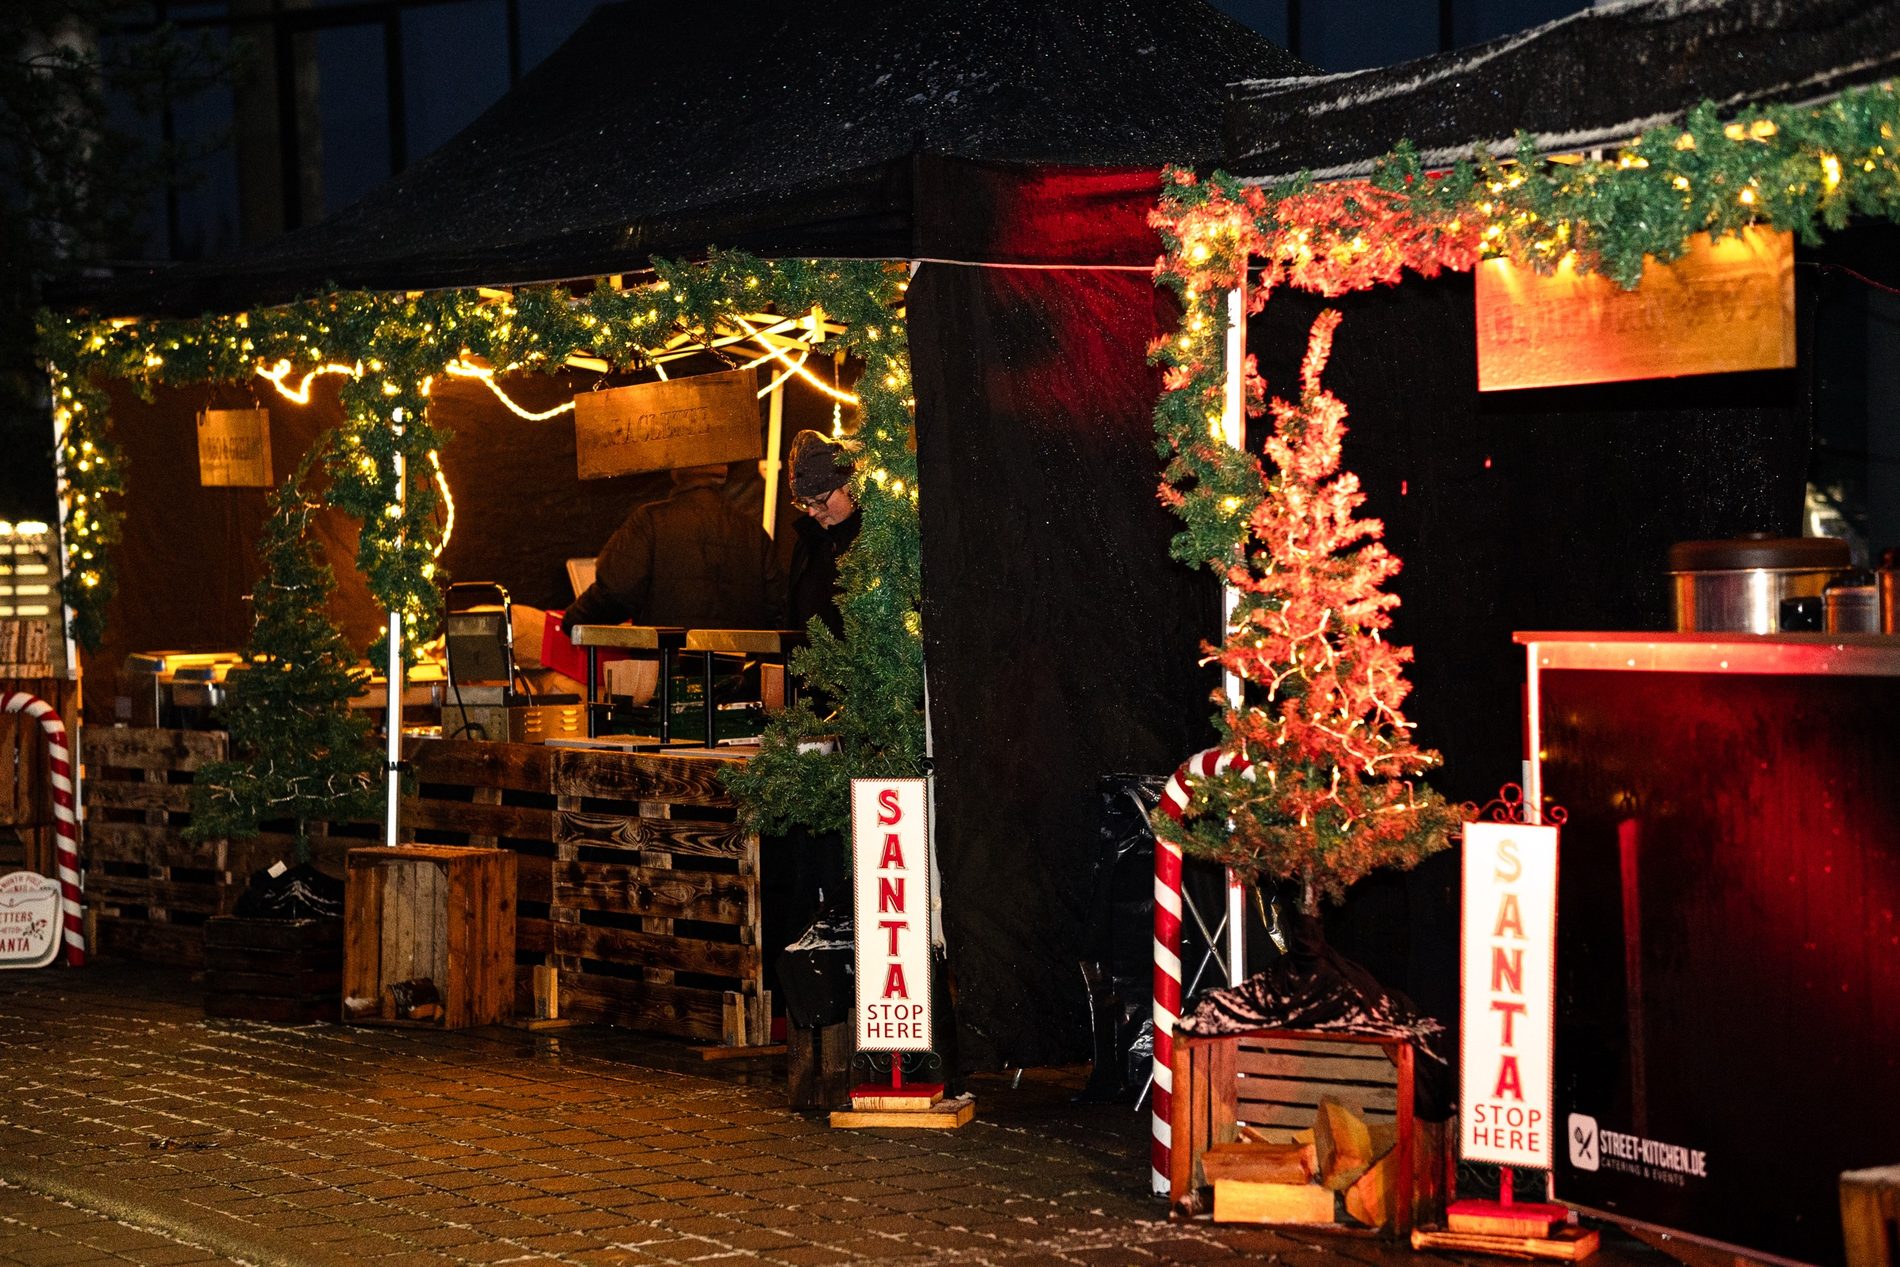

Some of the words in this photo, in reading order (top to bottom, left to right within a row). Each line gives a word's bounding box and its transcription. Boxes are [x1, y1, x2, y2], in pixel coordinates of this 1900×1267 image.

[876, 787, 911, 1000] SANTA
[1490, 838, 1529, 1103] SANTA
[867, 1004, 924, 1021] STOP
[867, 1022, 924, 1039] HERE
[1473, 1103, 1542, 1130] STOP
[1473, 1126, 1540, 1153] HERE
[1600, 1128, 1707, 1178] STREET-KITCHEN.DE
[1601, 1156, 1641, 1177] CATERING
[1643, 1166, 1651, 1179] &
[1652, 1168, 1685, 1187] EVENTS
